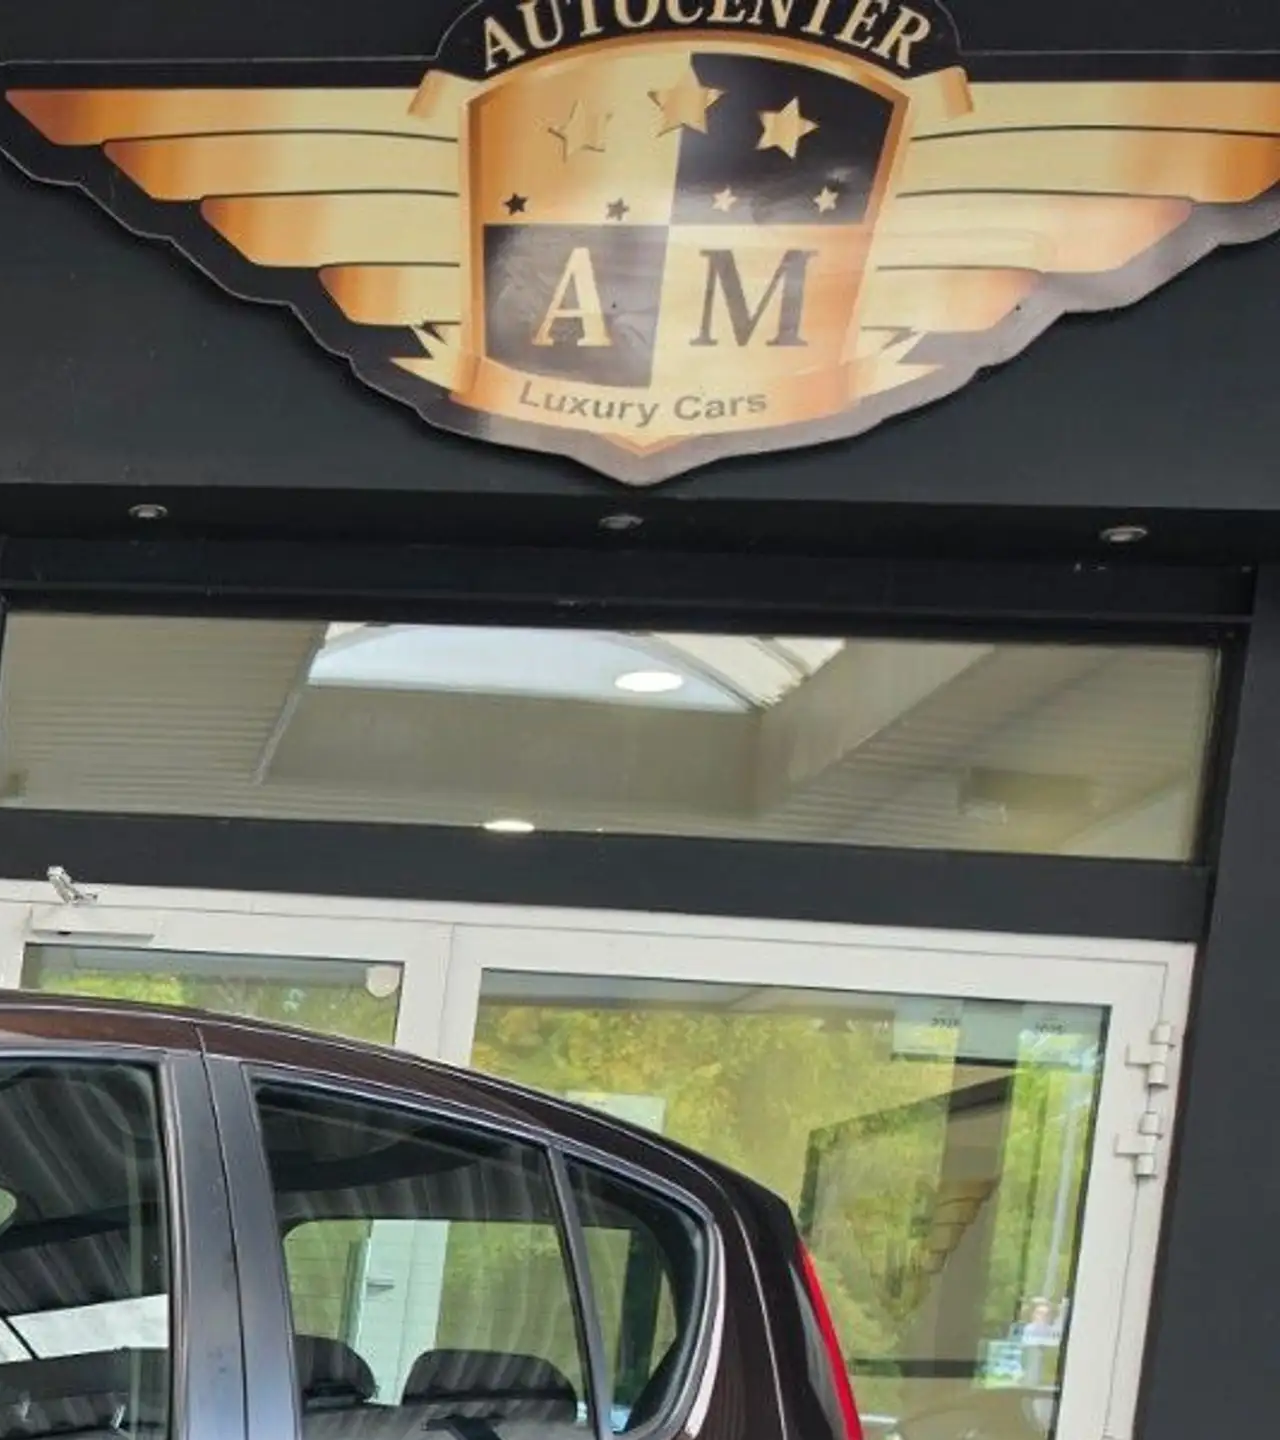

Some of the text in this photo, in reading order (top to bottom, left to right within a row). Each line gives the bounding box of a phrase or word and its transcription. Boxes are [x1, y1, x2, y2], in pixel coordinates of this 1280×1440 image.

[482, 0, 932, 72] AUTOCENTER
[531, 246, 819, 347] A M
[518, 379, 768, 428] Luxury Cars
